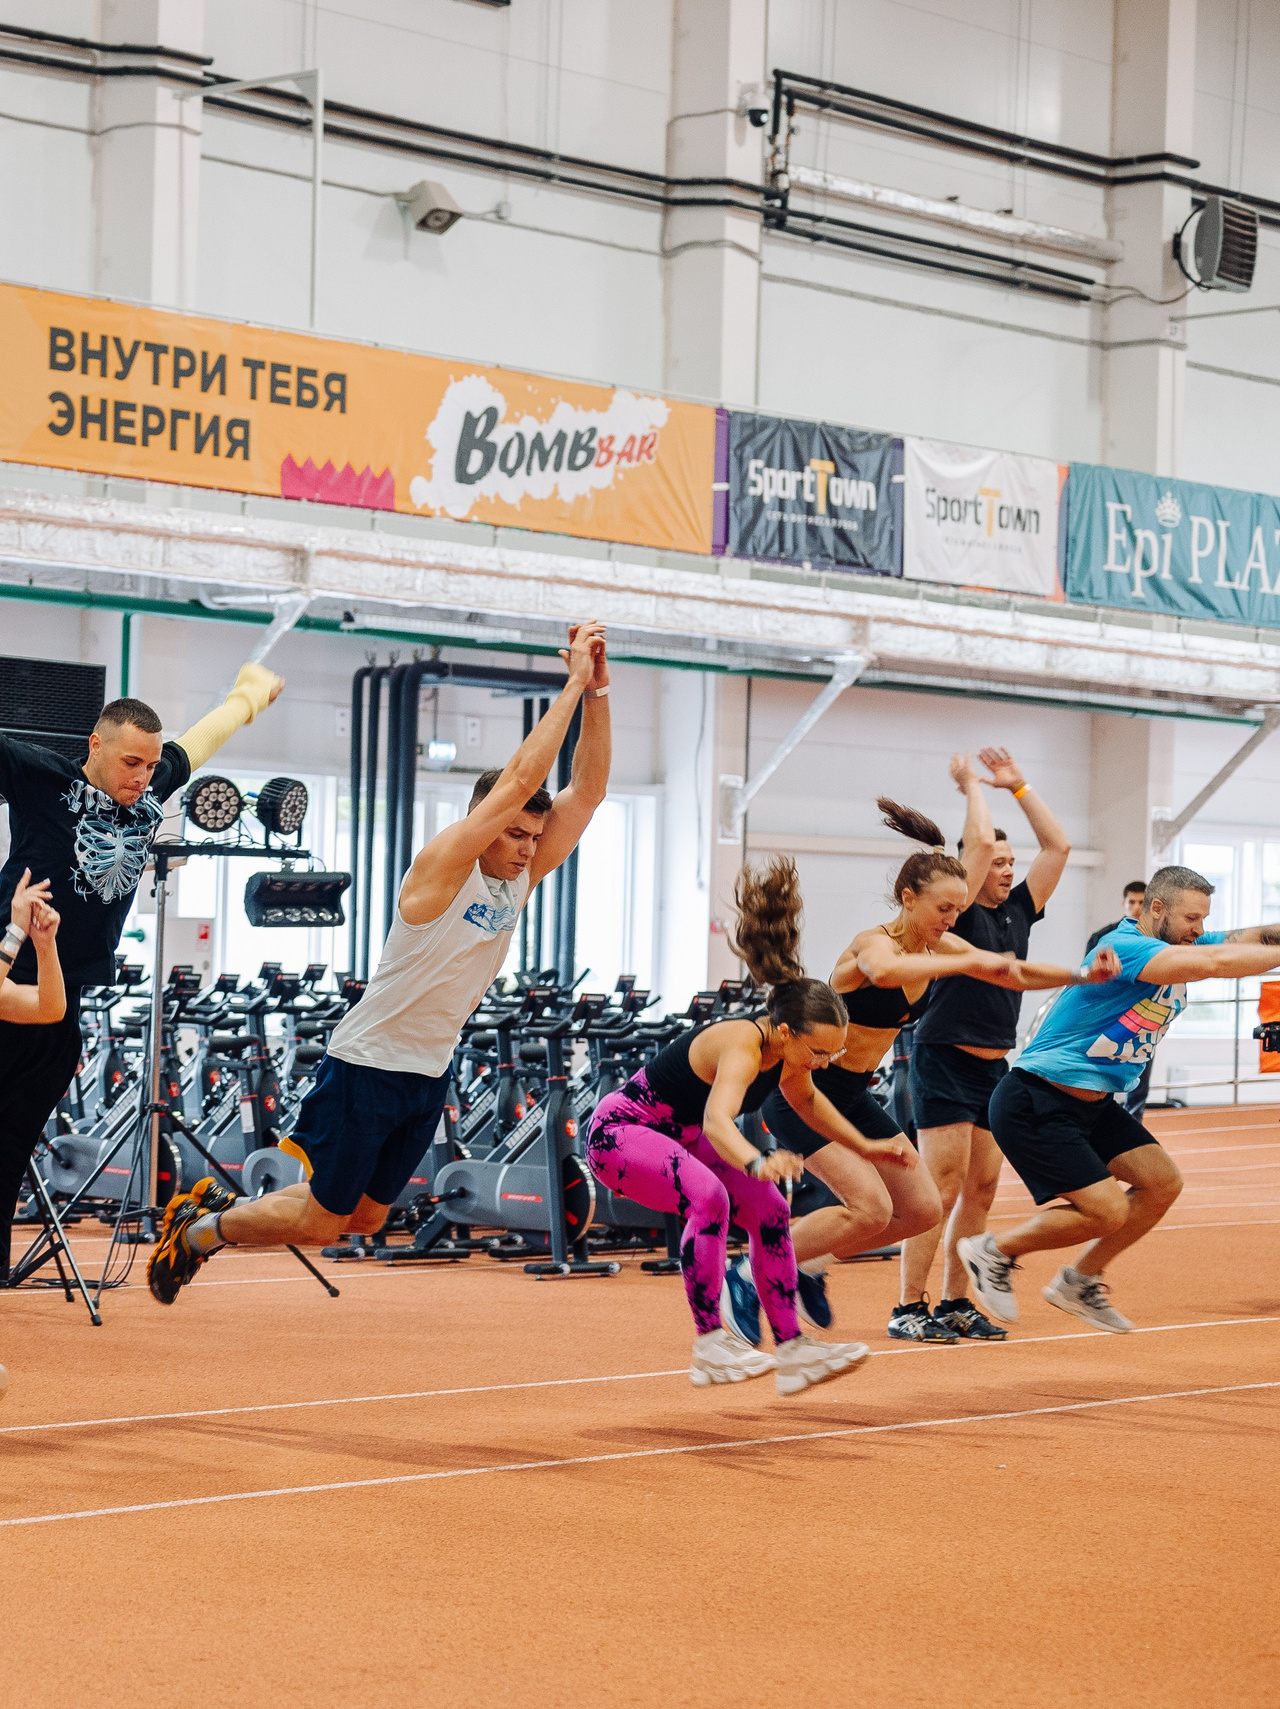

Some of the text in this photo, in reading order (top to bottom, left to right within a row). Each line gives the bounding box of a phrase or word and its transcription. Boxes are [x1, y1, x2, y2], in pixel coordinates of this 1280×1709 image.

[48, 326, 348, 414] ВНУТРИ ТЕБЯ
[47, 391, 251, 461] ЭНЕРГИЯ
[748, 458, 877, 515] SportTown
[925, 486, 1041, 538] SportTown
[1103, 501, 1173, 598] Epi
